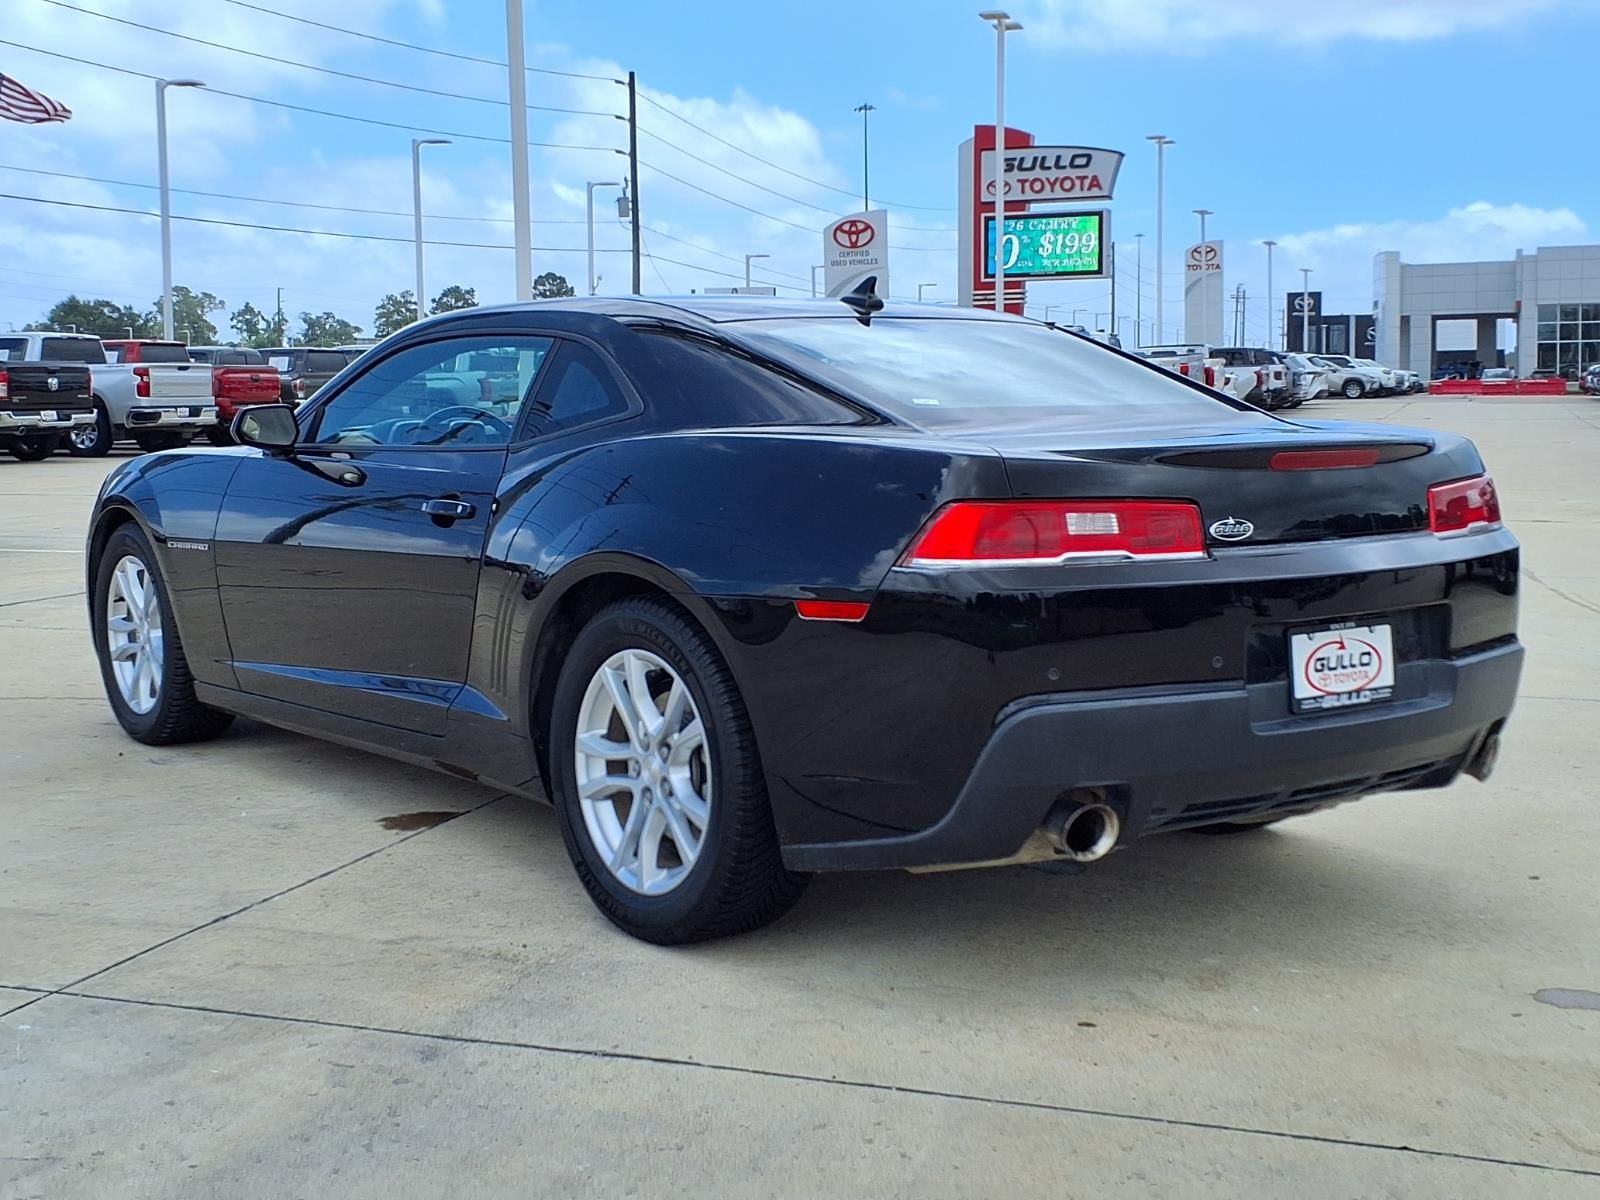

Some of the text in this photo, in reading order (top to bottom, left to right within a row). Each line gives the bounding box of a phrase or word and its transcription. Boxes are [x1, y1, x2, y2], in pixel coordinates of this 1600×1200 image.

[1003, 153, 1092, 173] GULLO
[1016, 175, 1103, 194] TOYOTA
[1039, 231, 1096, 257] $199
[830, 258, 878, 267] USED VEHICLES
[839, 250, 870, 258] CERTIFIED
[167, 541, 209, 551] CAMARO
[1314, 651, 1372, 673] GULLO
